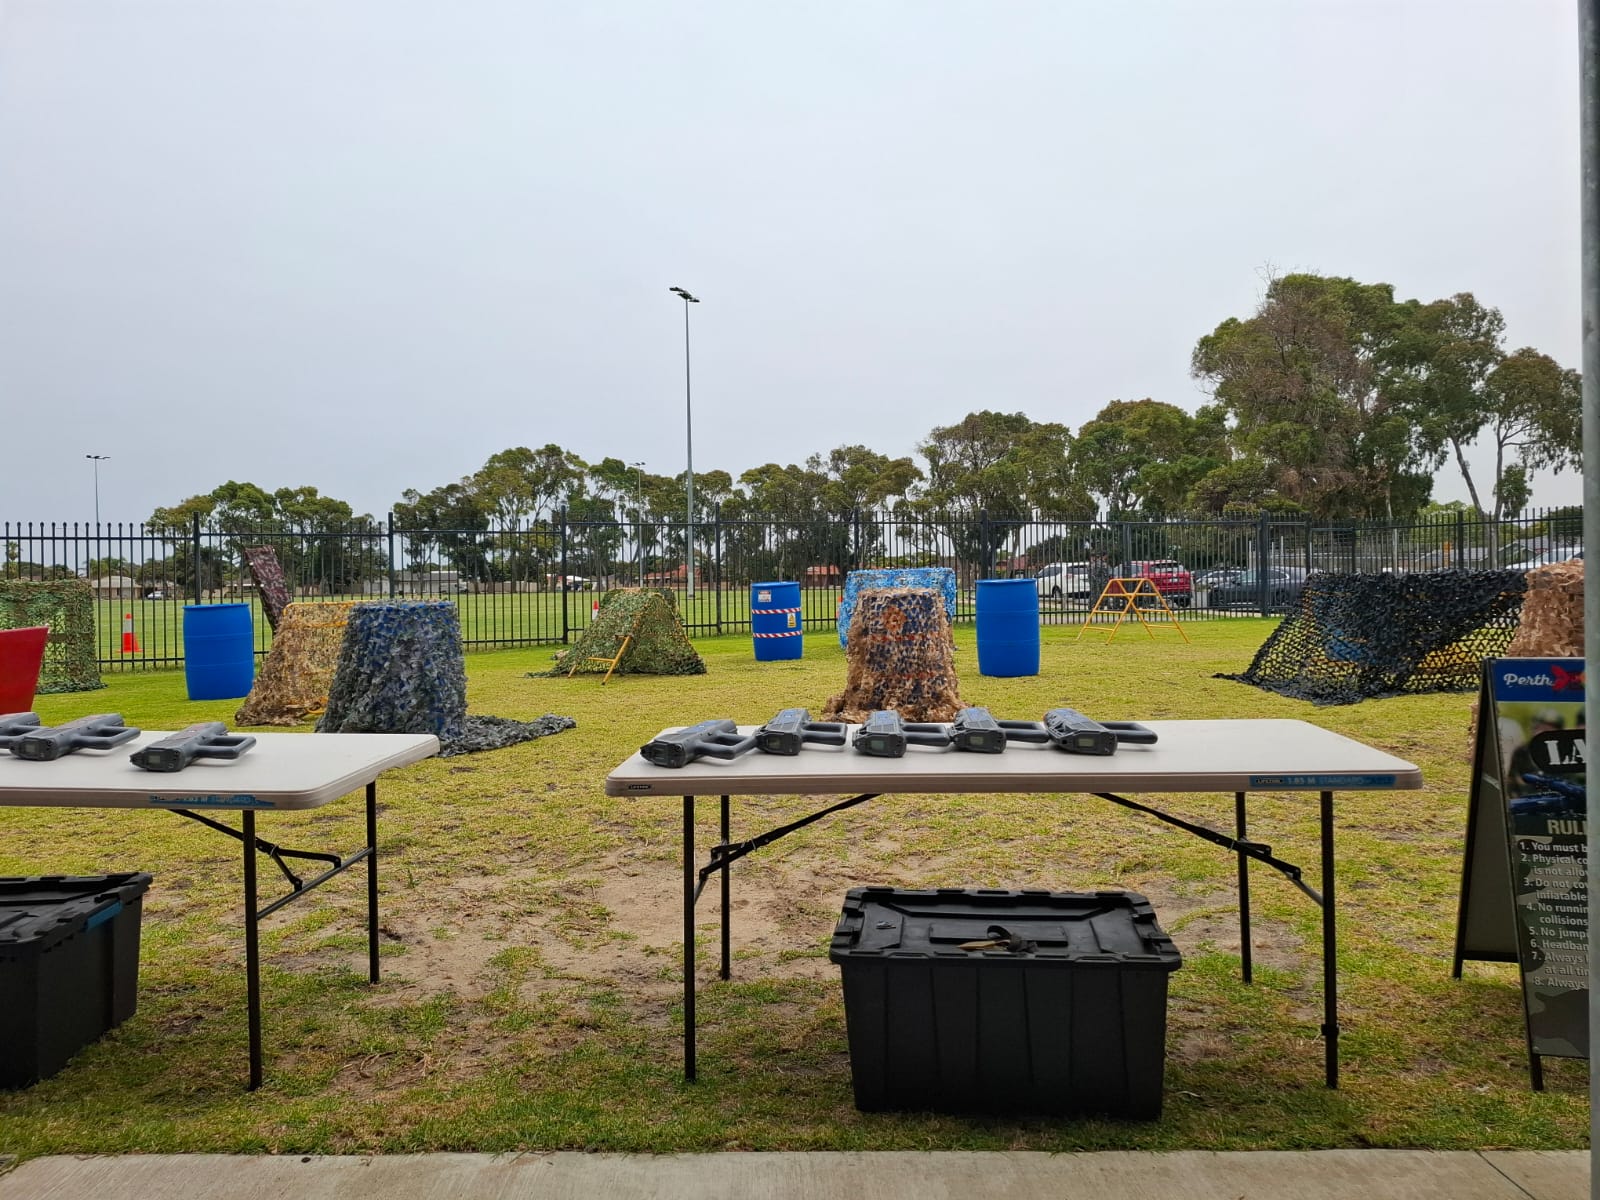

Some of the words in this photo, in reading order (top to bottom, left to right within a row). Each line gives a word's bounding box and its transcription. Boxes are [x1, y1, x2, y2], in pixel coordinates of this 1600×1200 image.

[1503, 673, 1555, 688] Perth
[1520, 842, 1529, 850] 1.
[1531, 842, 1551, 851] You
[1553, 844, 1579, 852] must
[1521, 853, 1530, 862] 2.
[1532, 854, 1574, 865] Physical
[1545, 867, 1562, 875] not
[1523, 877, 1533, 886] 3.
[1535, 878, 1549, 887] Do
[1553, 879, 1570, 888] not
[1526, 902, 1536, 911] 4.
[1538, 902, 1553, 912] No
[1529, 927, 1538, 936] 5.
[1540, 927, 1556, 937] No
[1530, 939, 1540, 948] 6.
[1531, 951, 1542, 961] 7.
[1544, 951, 1583, 965] Always
[1545, 965, 1557, 975] at
[1559, 965, 1573, 975] all
[1534, 976, 1545, 986] 8.
[1547, 976, 1585, 991] Always
